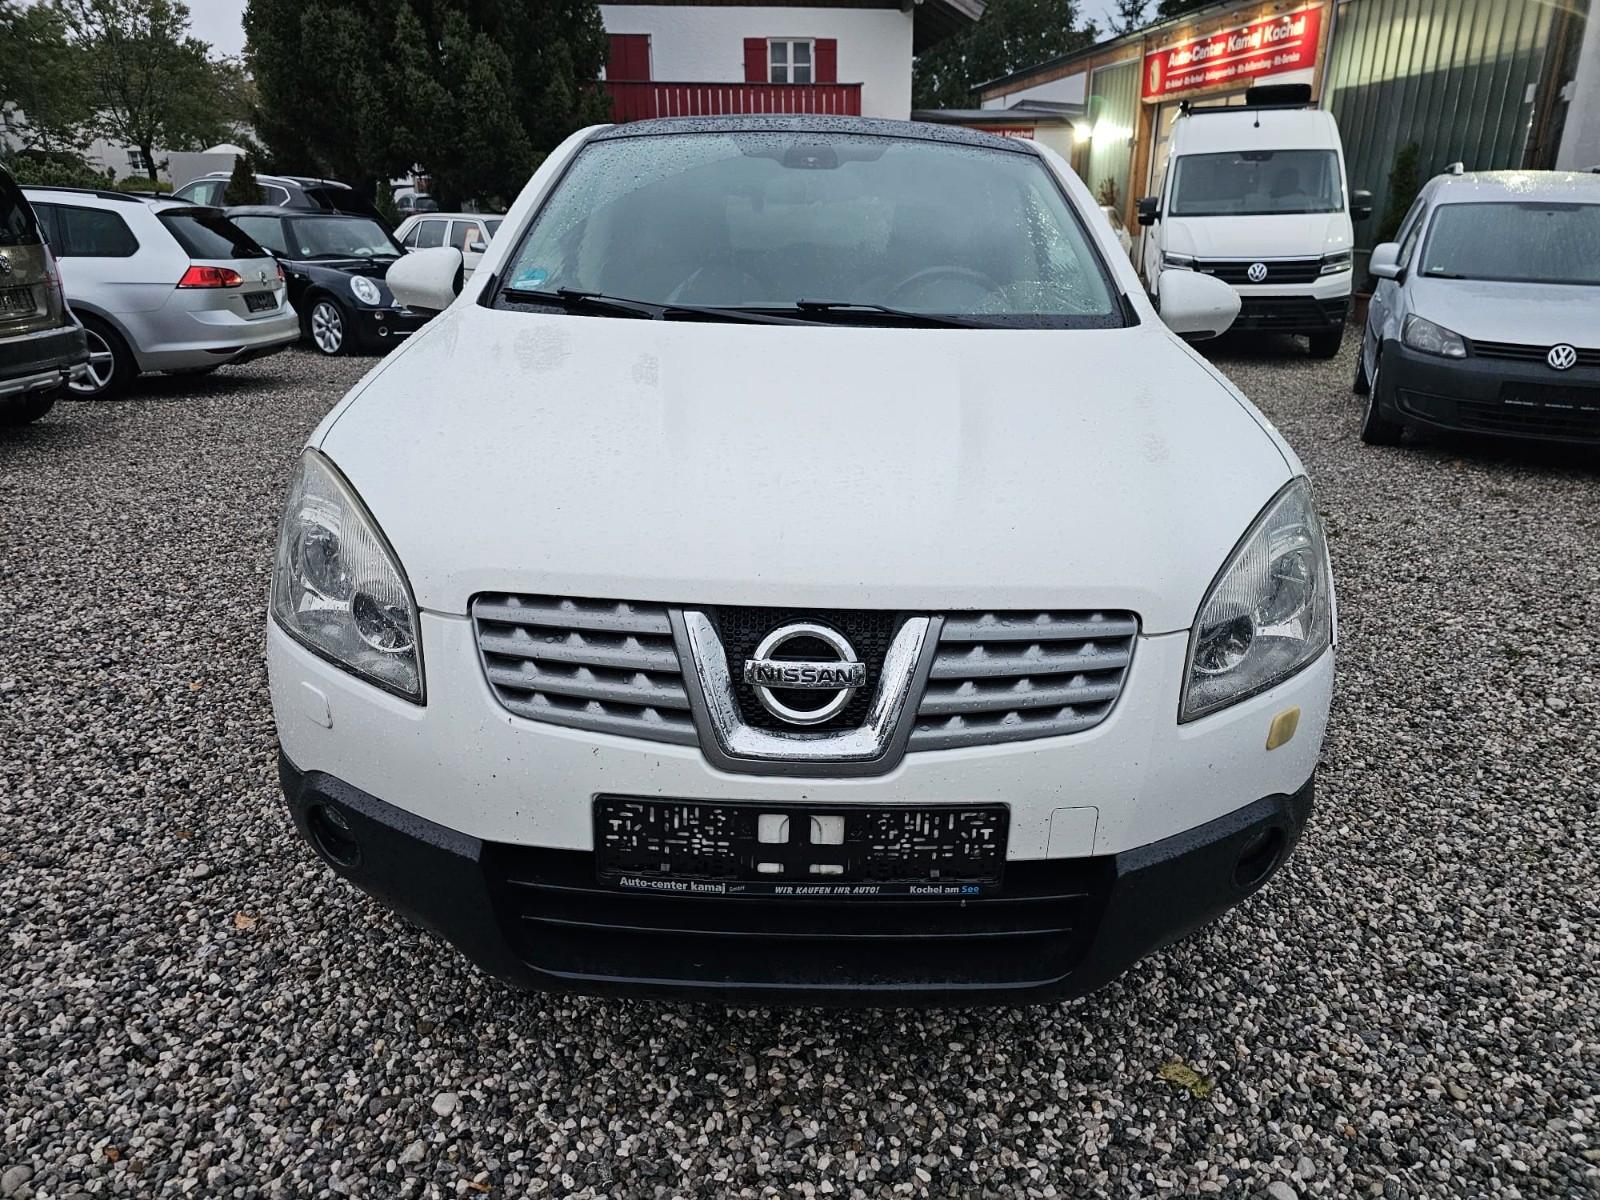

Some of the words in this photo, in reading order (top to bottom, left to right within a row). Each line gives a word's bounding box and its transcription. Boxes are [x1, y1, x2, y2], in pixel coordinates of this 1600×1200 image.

[1168, 41, 1226, 68] Auto-Center
[1264, 16, 1306, 44] Kochel
[1548, 345, 1577, 370] VW
[757, 667, 854, 683] NISSAN
[619, 876, 688, 890] Auto-center
[691, 881, 726, 894] kamaj
[775, 886, 793, 895] WIR
[796, 886, 831, 895] KAUFEN
[834, 886, 850, 895] IHR
[853, 886, 880, 895] AUTO!
[910, 885, 942, 894] Kochel
[962, 885, 980, 894] See
